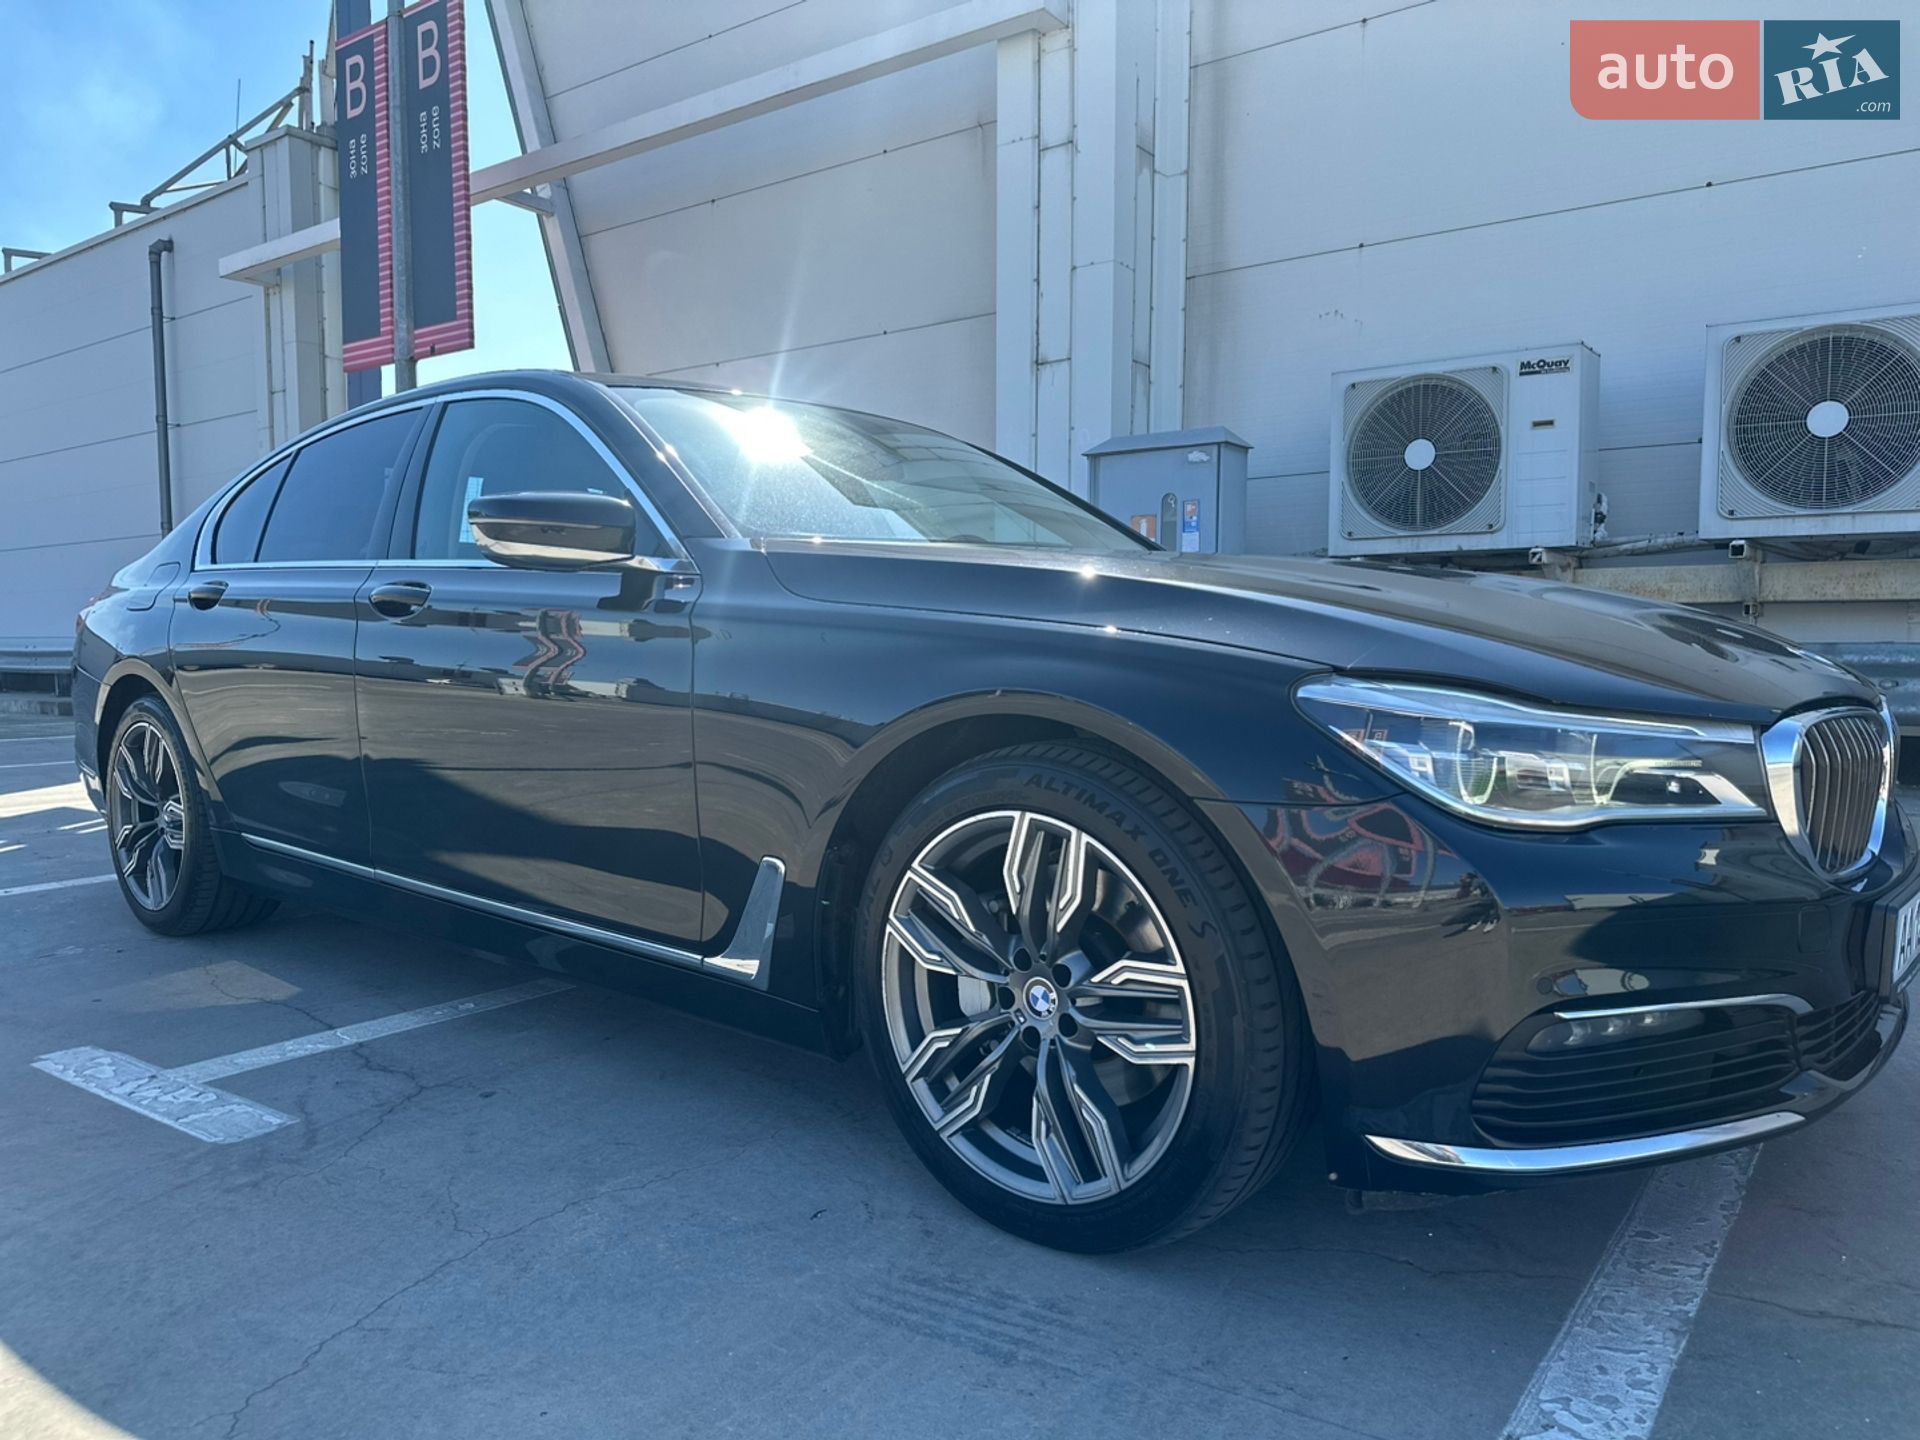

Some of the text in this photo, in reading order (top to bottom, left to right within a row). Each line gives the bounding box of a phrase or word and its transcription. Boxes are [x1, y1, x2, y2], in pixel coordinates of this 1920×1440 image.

[345, 54, 367, 120] B
[417, 19, 441, 90] B
[1520, 359, 1570, 370] McQuay
[1023, 773, 1149, 842] ALTIMAX
[1150, 849, 1199, 908] ONE
